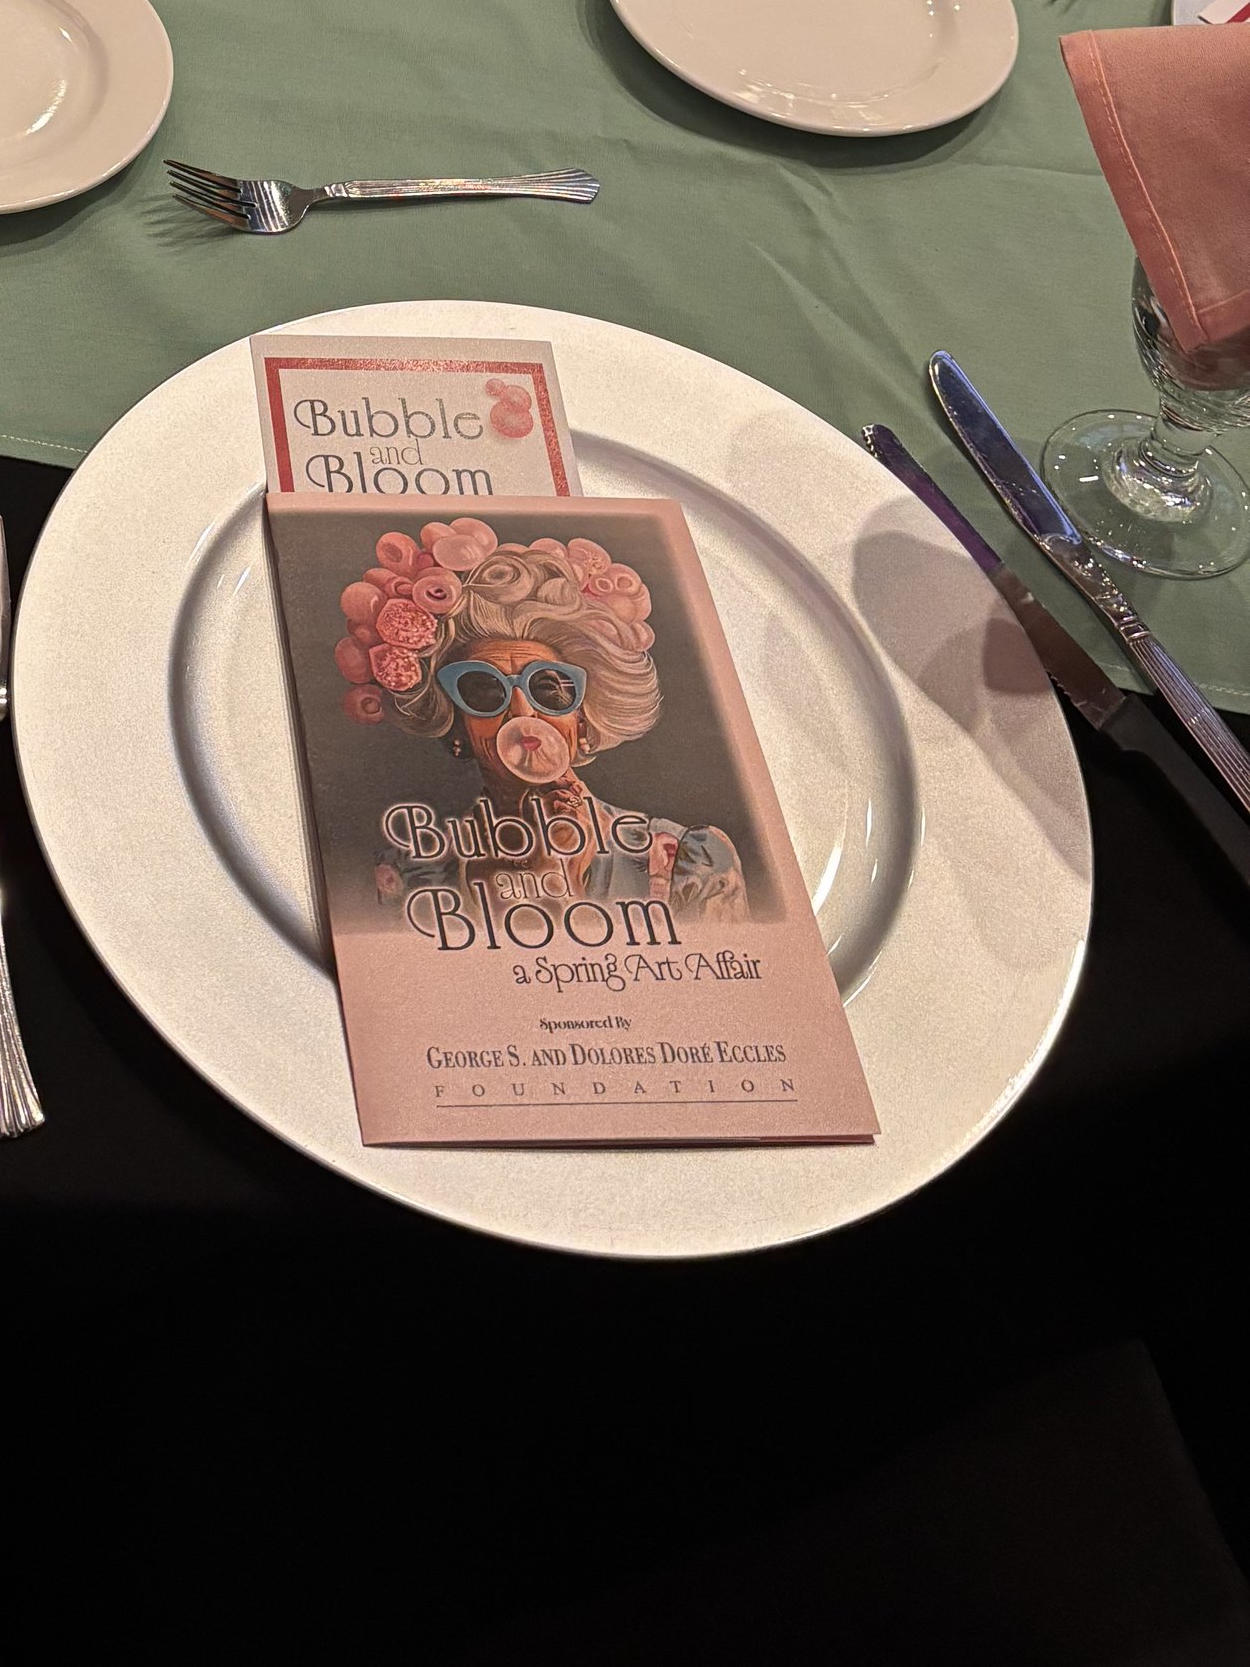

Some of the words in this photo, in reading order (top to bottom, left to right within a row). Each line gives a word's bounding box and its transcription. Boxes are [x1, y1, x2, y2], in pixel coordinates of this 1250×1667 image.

[293, 397, 484, 440] Bubble
[369, 438, 424, 466] and
[305, 451, 494, 496] Bloom
[383, 797, 654, 861] Bubble
[495, 858, 575, 900] and
[406, 881, 682, 952] Bloom
[512, 964, 531, 985] a
[534, 952, 626, 994] Spring
[623, 953, 683, 983] Art
[684, 949, 763, 982] Affair
[539, 1016, 613, 1033] Sponsored
[614, 1016, 632, 1032] By
[507, 1045, 527, 1068] S.
[434, 1077, 795, 1099] FOUNDATION
